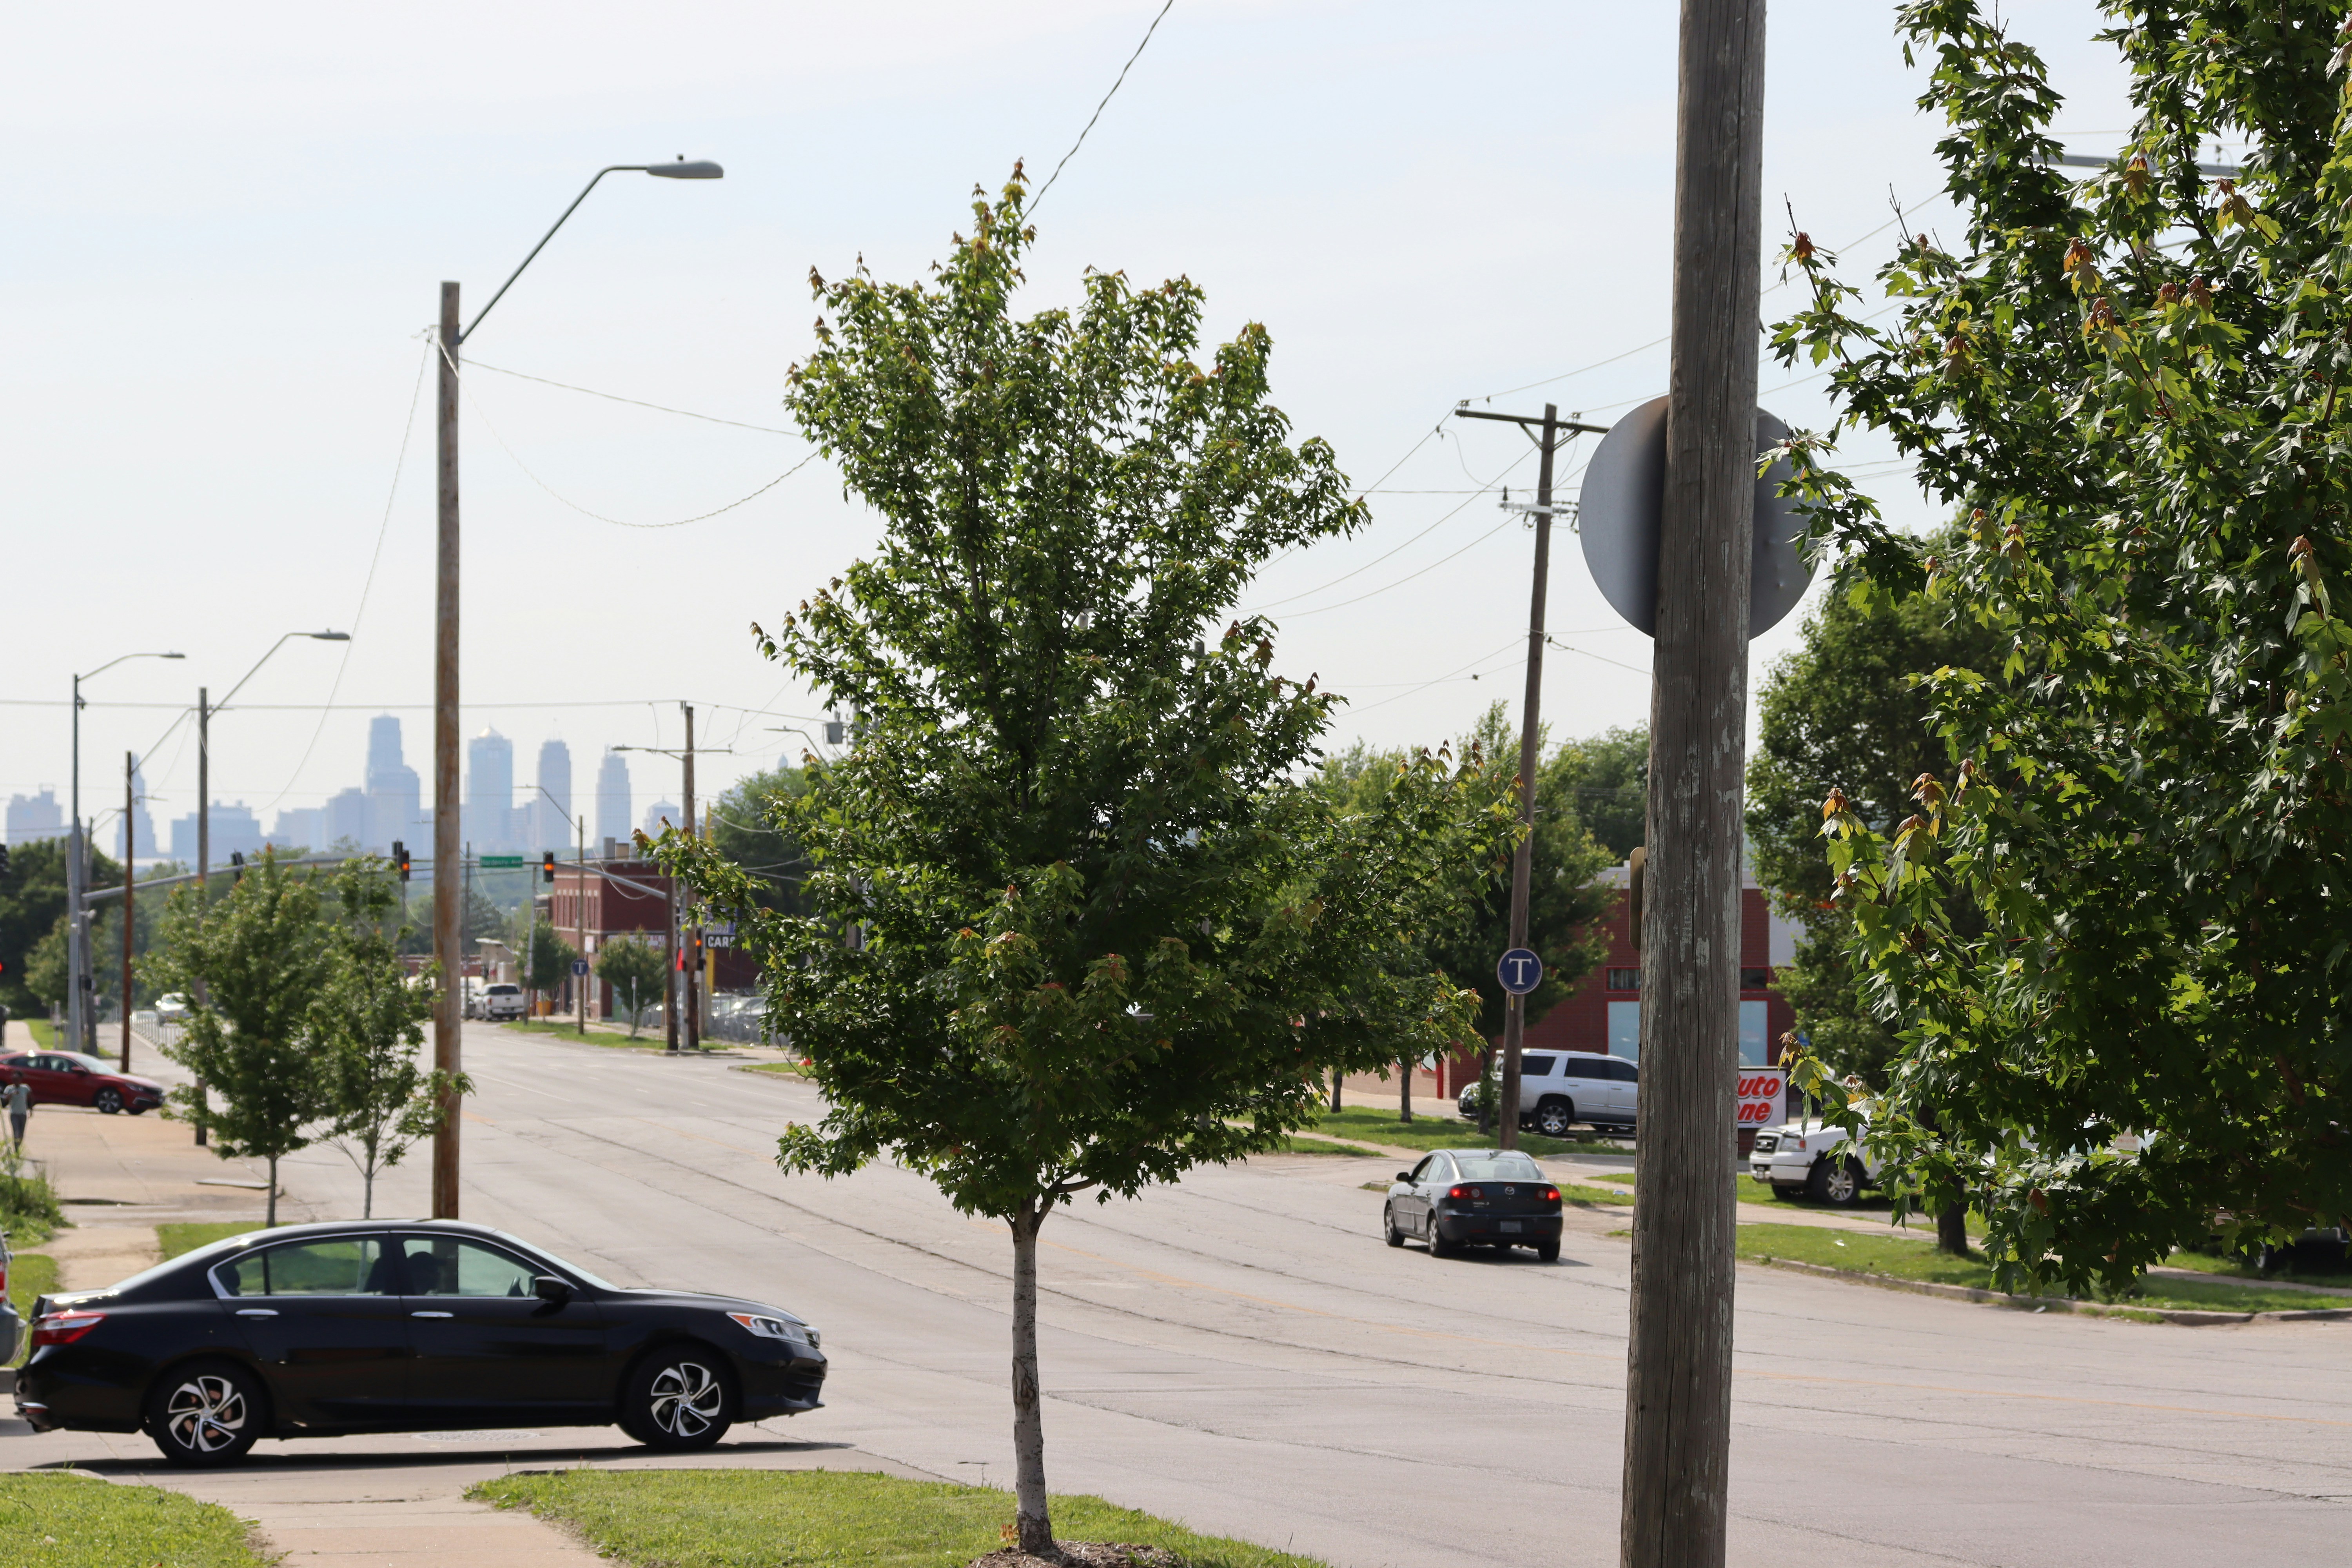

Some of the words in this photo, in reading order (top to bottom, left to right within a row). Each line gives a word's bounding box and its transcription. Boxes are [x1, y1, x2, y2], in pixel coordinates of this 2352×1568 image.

[575, 962, 585, 973] T
[1509, 958, 1532, 985] T
[1738, 1074, 1781, 1098] uto
[1738, 1102, 1771, 1122] ne
